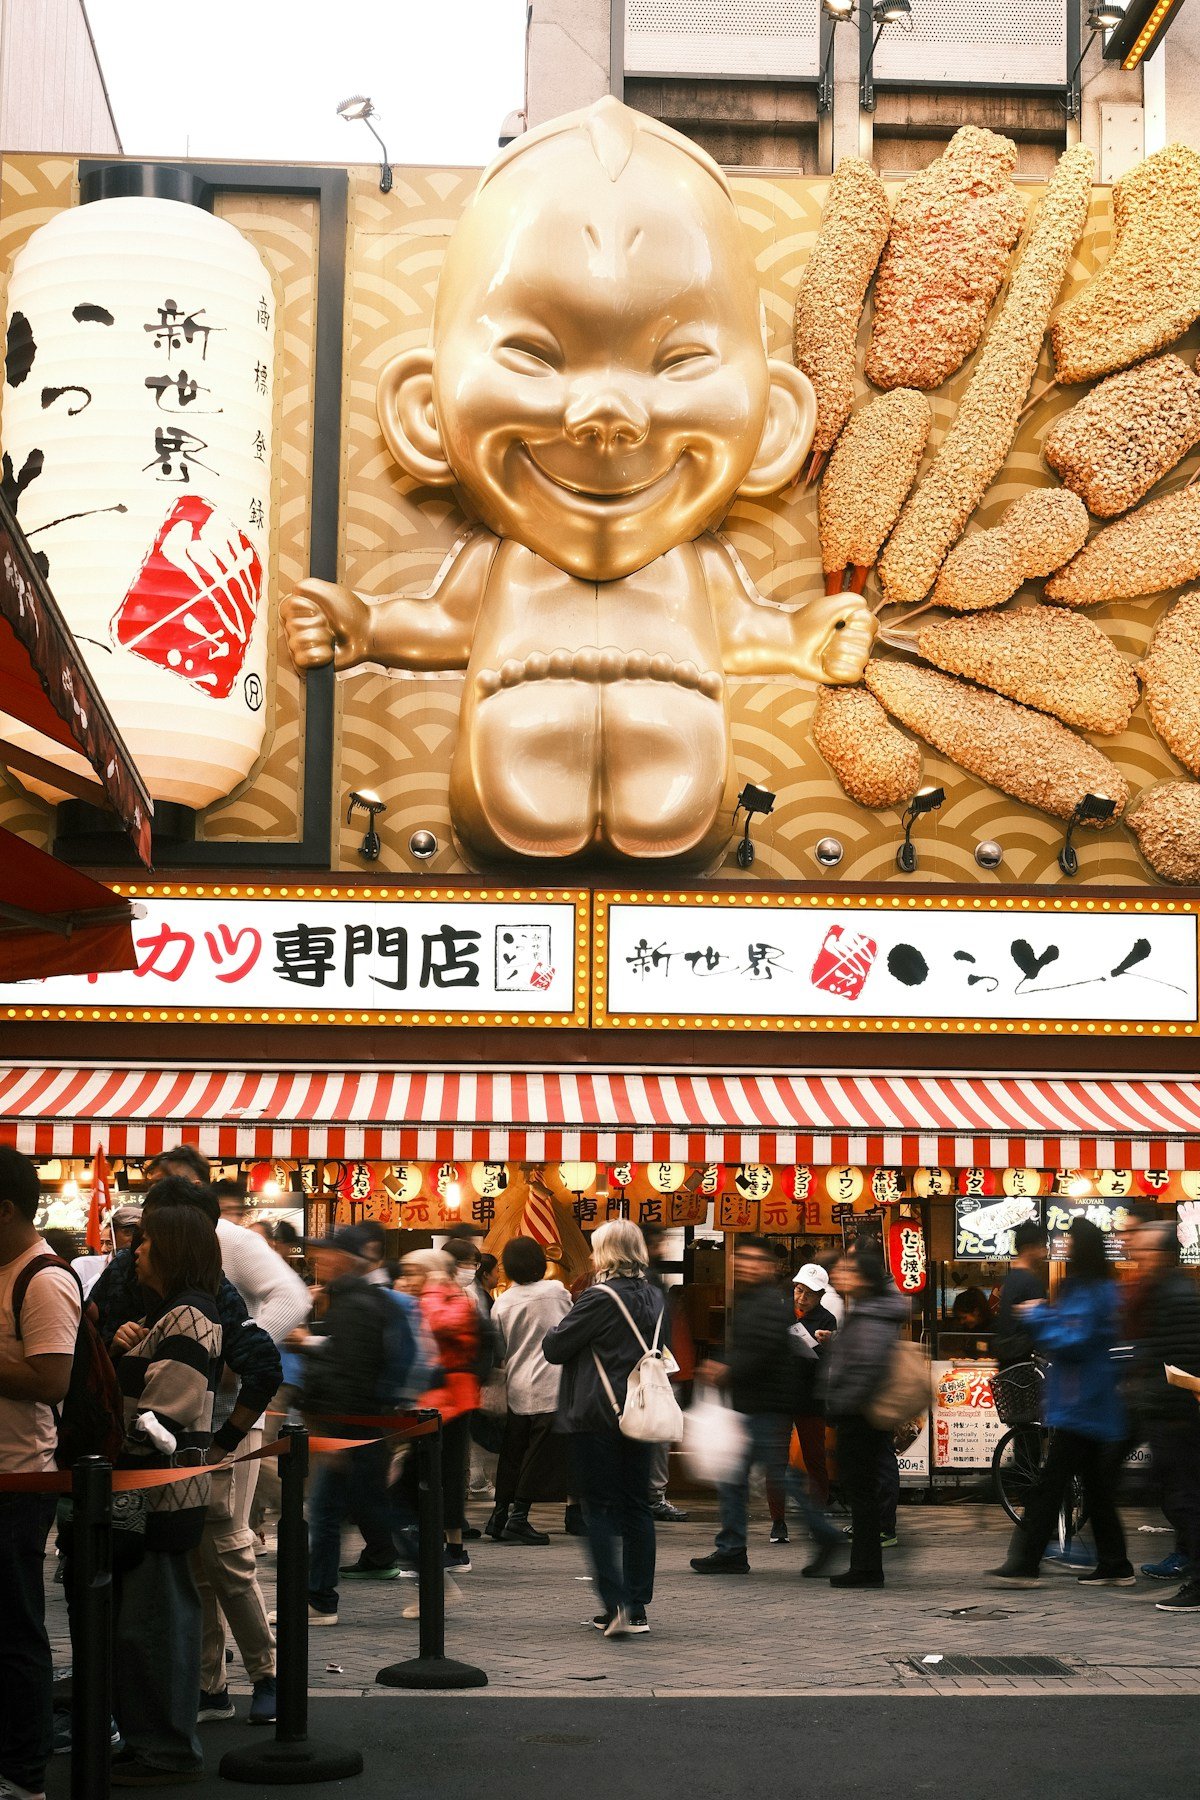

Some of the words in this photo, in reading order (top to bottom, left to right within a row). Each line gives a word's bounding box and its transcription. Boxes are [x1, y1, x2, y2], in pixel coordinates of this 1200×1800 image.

[142, 299, 227, 482] 新世界
[249, 296, 270, 531] 商標登録
[72, 923, 482, 991] カツ専門店
[626, 939, 793, 982] 新世界
[355, 1163, 369, 1198] 玉ねぎ
[482, 1165, 498, 1195] しょうが
[839, 1167, 854, 1200] イワシ
[874, 1169, 889, 1201] 本揚げ
[902, 1230, 919, 1287] たこ焼き
[896, 1458, 919, 1470] 80円
